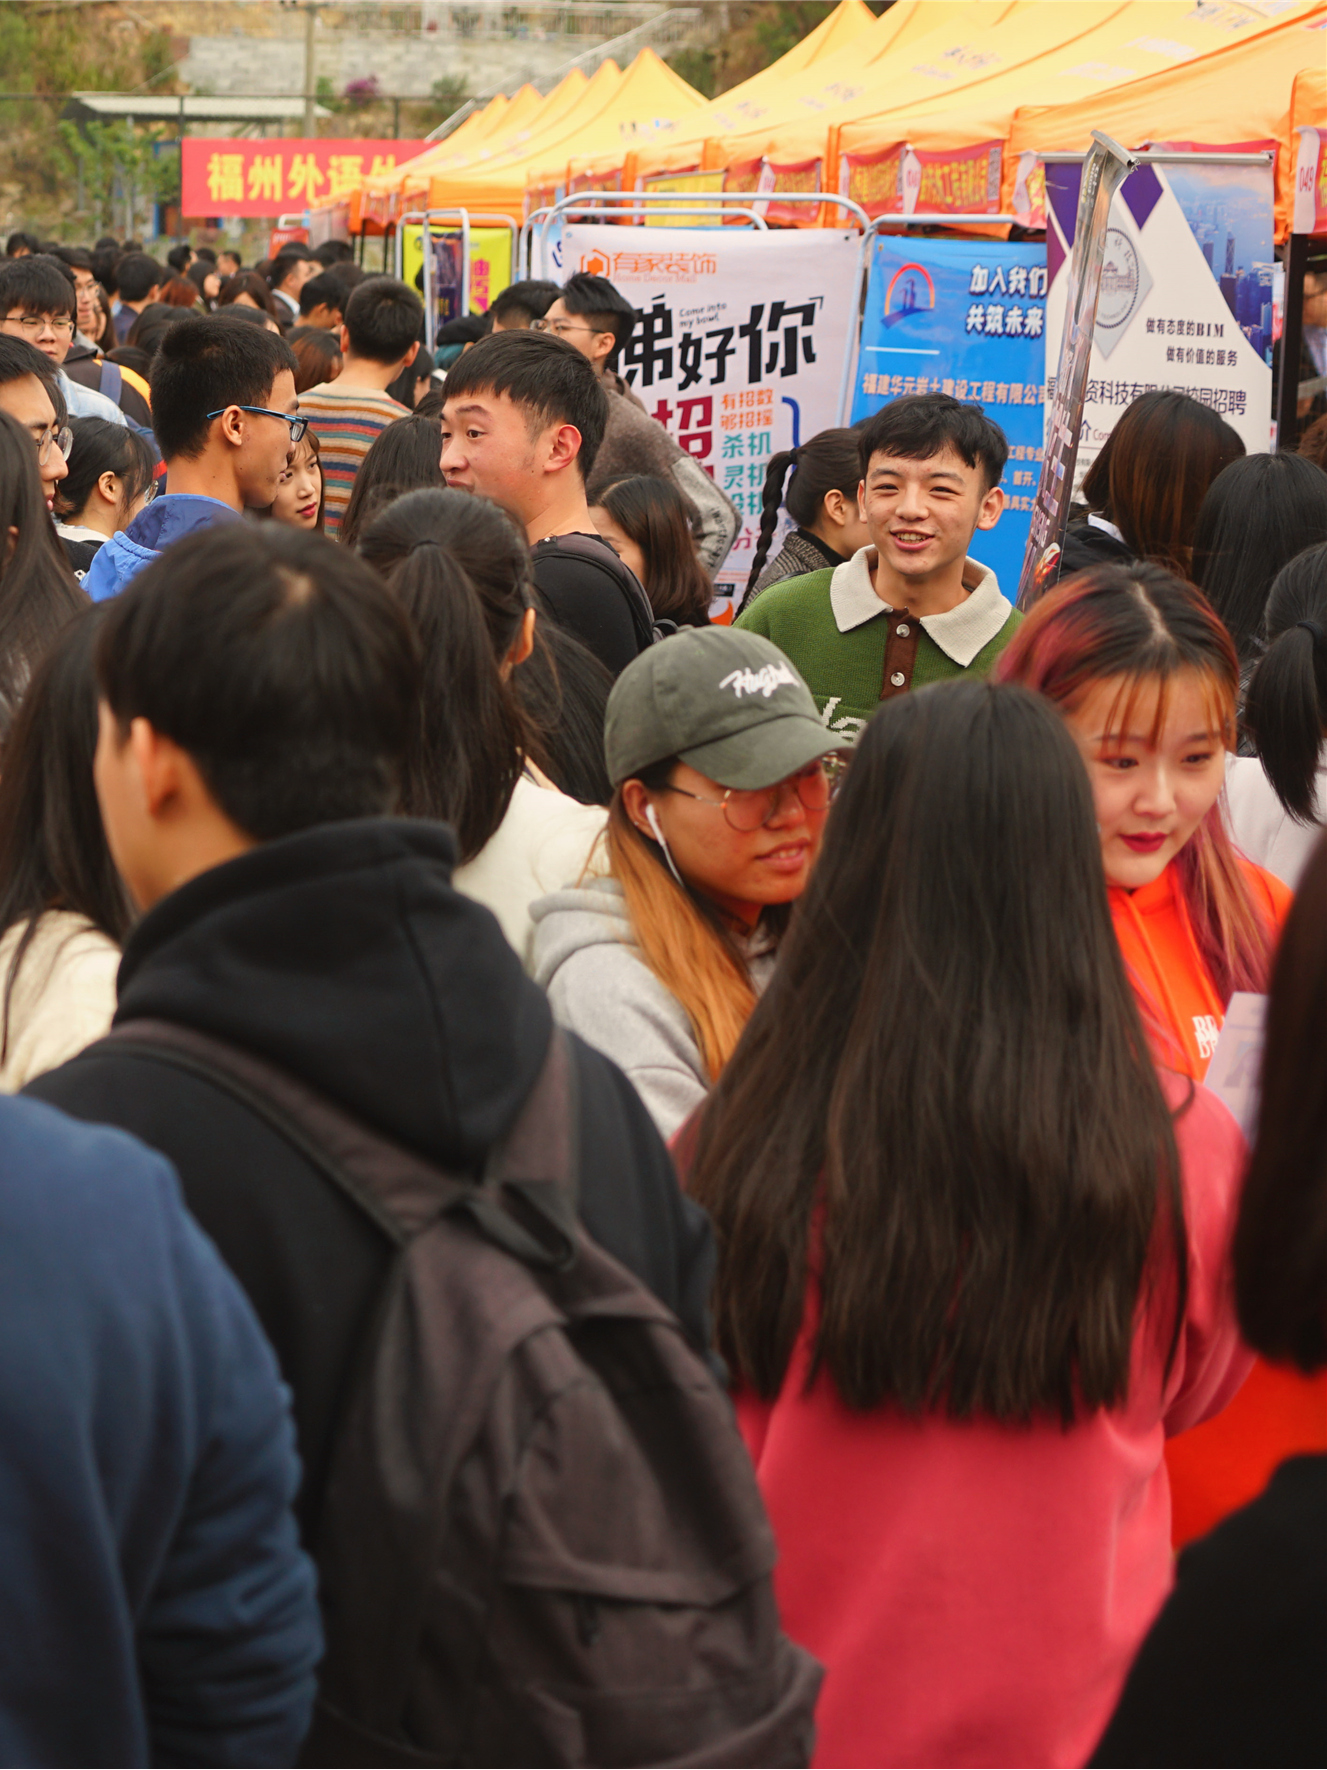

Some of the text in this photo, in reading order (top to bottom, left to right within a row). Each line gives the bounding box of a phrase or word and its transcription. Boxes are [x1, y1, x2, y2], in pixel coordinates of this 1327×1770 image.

[1298, 166, 1314, 192] 049
[613, 251, 718, 274] 有家装饰
[969, 264, 1048, 297] 加入我们
[679, 307, 704, 318] Come
[679, 319, 693, 329] my
[965, 303, 1045, 338] 共筑未来
[1166, 346, 1238, 367] 做有价值的服务
[1084, 379, 1248, 416] 资科技有园招聘
[722, 431, 772, 459] 杀机
